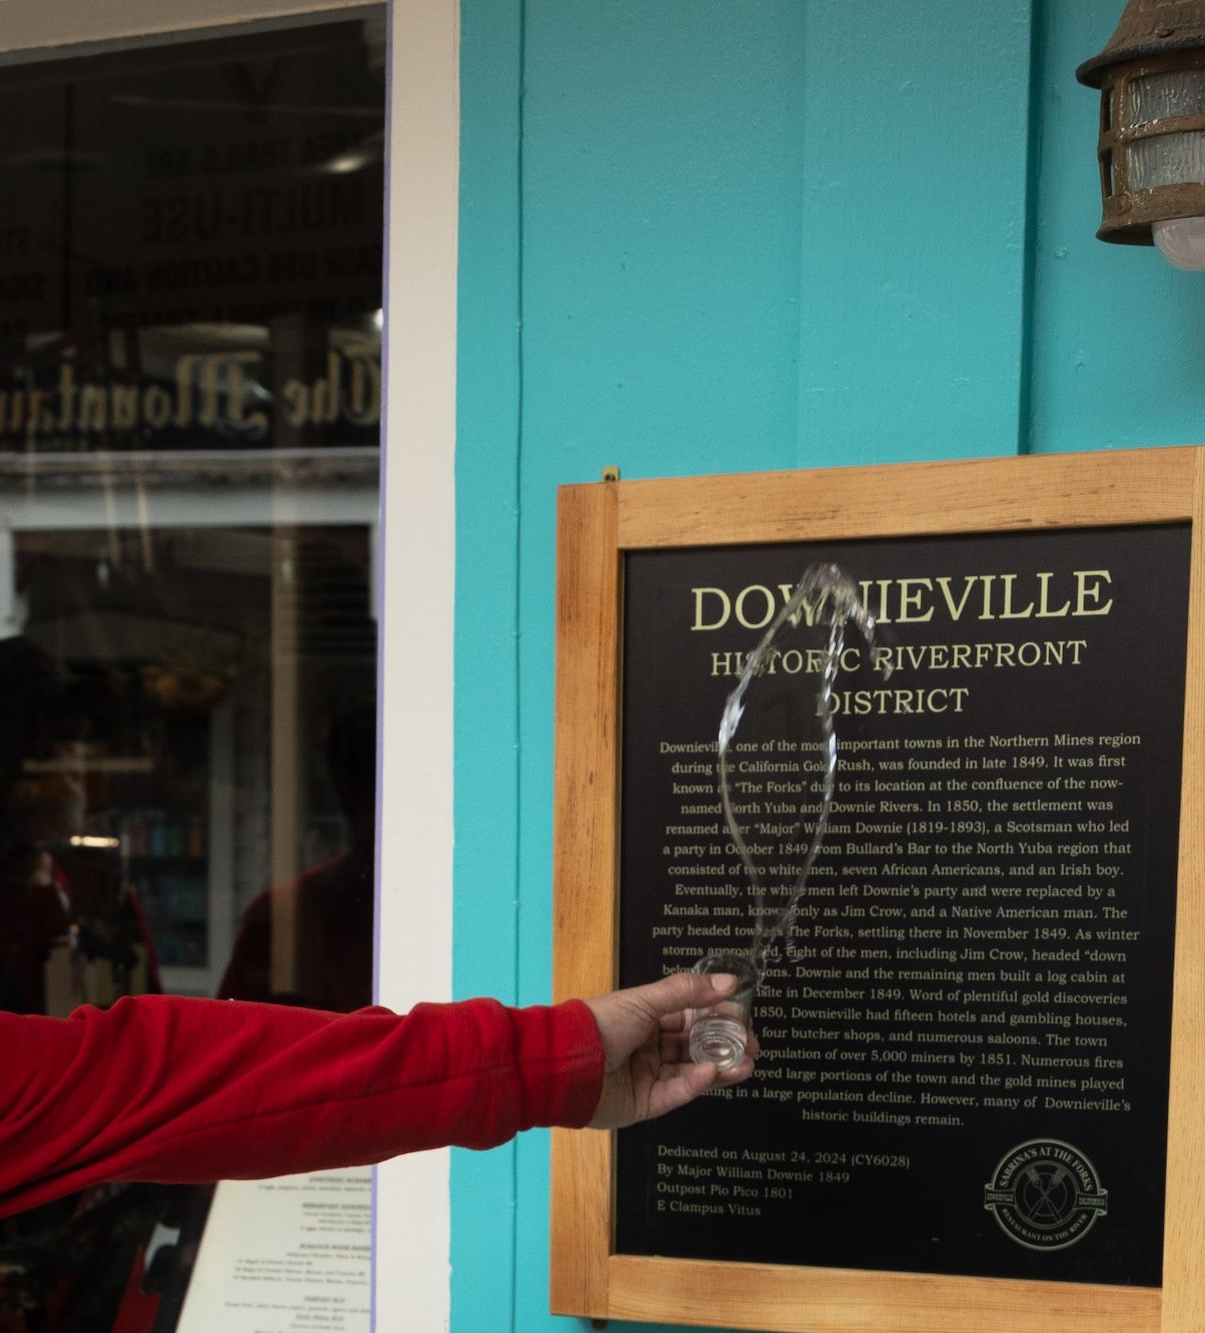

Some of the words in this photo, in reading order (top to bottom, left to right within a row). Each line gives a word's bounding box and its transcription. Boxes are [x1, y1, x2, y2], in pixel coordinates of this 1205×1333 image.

[711, 648, 861, 676] HITORC
[874, 639, 1087, 672] RIVERFRONT
[816, 688, 969, 717] DISTRICT
[903, 739, 944, 749] towns
[988, 735, 1050, 747] Northern
[1053, 734, 1095, 746] Mines
[1097, 735, 1142, 747] region
[738, 760, 801, 772] California
[907, 758, 961, 770] founded
[1012, 757, 1049, 768] 1849.
[673, 783, 715, 793] known
[874, 780, 926, 791] location
[970, 778, 1044, 789] confluence
[763, 802, 798, 813] Yuba
[880, 801, 924, 812] Rivers.
[1011, 800, 1084, 811] settlement
[665, 824, 719, 834] renamed
[905, 821, 991, 835] (1819-1893),
[1006, 821, 1074, 832] Scotsman
[976, 842, 1015, 853] North
[1056, 845, 1100, 856] region
[667, 864, 725, 874] consisted
[880, 864, 928, 875] African
[1025, 885, 1082, 899] replaced
[663, 904, 711, 915] Kanaka
[950, 907, 993, 917] Native
[995, 907, 1060, 917] American
[857, 926, 906, 941] settling
[963, 927, 1030, 939] November
[1095, 929, 1141, 940] winter
[895, 947, 958, 962] including
[988, 949, 1028, 961] Crow,
[796, 966, 843, 978] Downie
[897, 971, 965, 983] remaining
[802, 987, 866, 999] December
[962, 990, 1018, 1005] plentiful
[1052, 992, 1129, 1004] discoveries
[791, 1007, 863, 1019] Downieville
[1074, 1014, 1128, 1026] houses,
[790, 1028, 841, 1039] butcher
[916, 1034, 984, 1043] numerous
[986, 1032, 1042, 1045] saloons.
[755, 1045, 823, 1063] population
[910, 1054, 957, 1063] miners
[820, 1072, 873, 1083] portions
[920, 1093, 980, 1105] However,
[1044, 1097, 1132, 1111] Downieville's
[802, 1110, 850, 1121] historic
[852, 1111, 912, 1126] buildings
[914, 1116, 965, 1125] remain.
[657, 1145, 719, 1158] Dedicated
[721, 1151, 739, 1159] on
[740, 1150, 787, 1164] August
[789, 1151, 811, 1163] 24,
[814, 1152, 847, 1164] 2024
[850, 1154, 911, 1168] (CY6028)
[656, 1164, 675, 1174] By
[676, 1164, 714, 1179] Major
[715, 1167, 764, 1178] William
[767, 1169, 814, 1181] Downie
[819, 1172, 851, 1182] 1849
[999, 1147, 1038, 1188] SABRINA'S
[1039, 1146, 1053, 1158] AT
[1053, 1147, 1075, 1164] THE
[1071, 1158, 1094, 1192] FORKS
[655, 1183, 707, 1196] Outpost
[710, 1184, 730, 1195] Pio
[732, 1186, 760, 1197] Pico
[763, 1188, 793, 1198] 1801
[656, 1200, 667, 1211] E
[668, 1201, 725, 1215] Clampus
[727, 1204, 762, 1216] Vitus
[1069, 1212, 1088, 1234] RIVER
